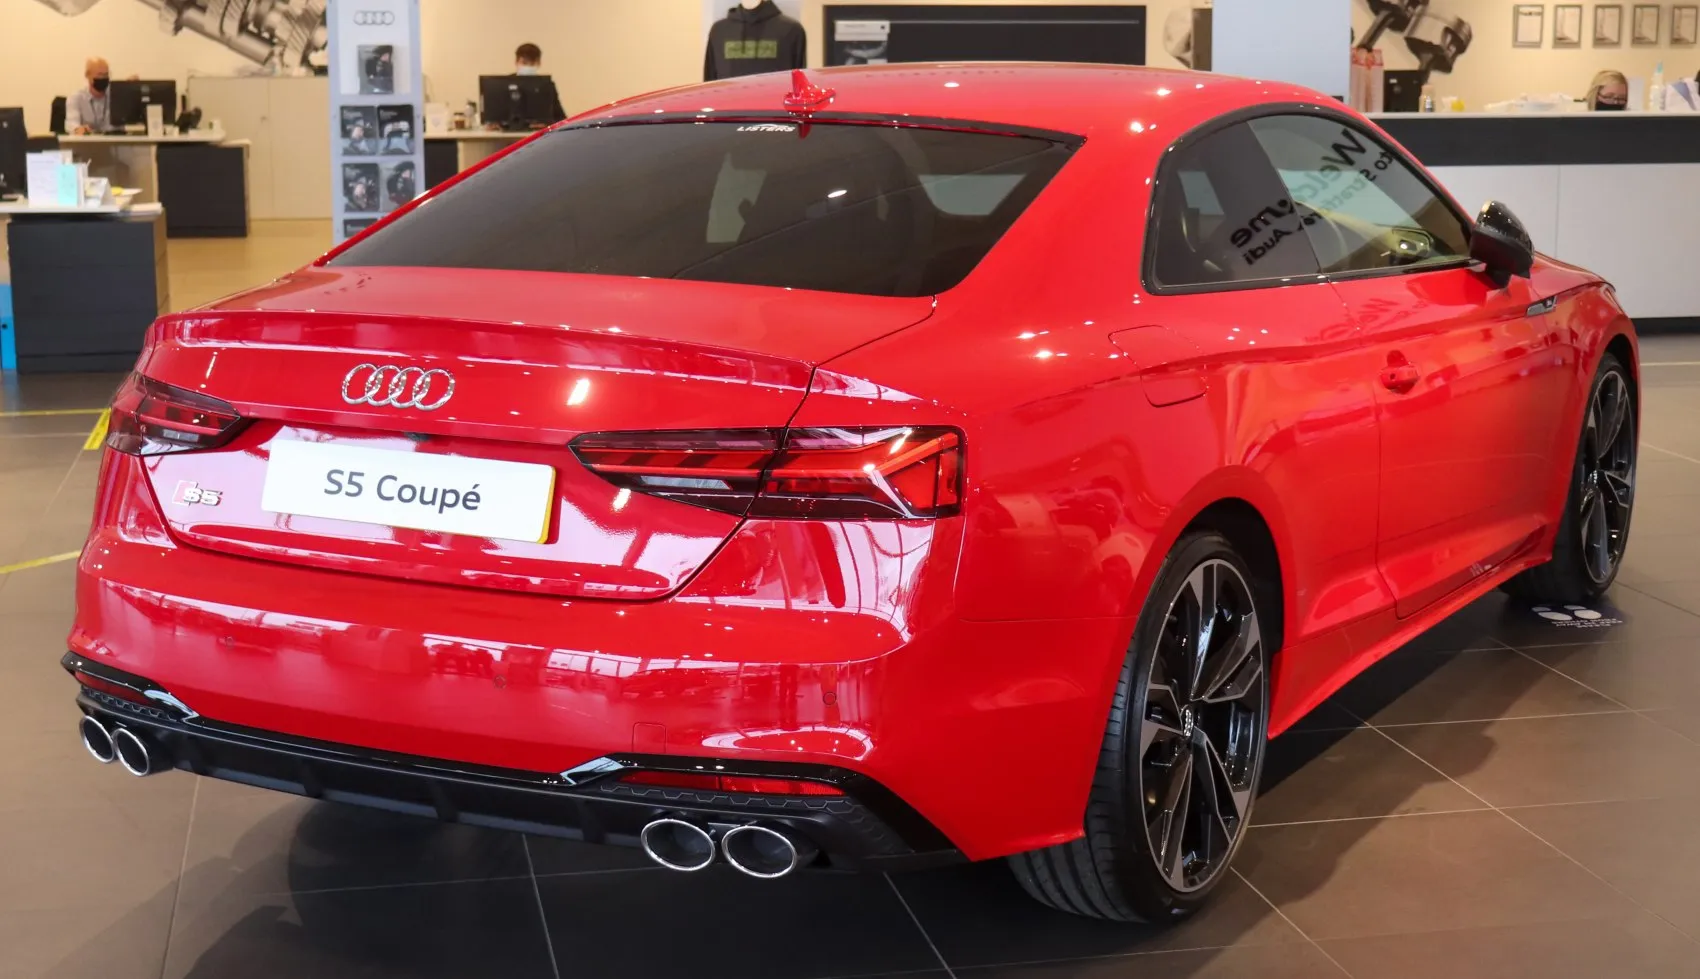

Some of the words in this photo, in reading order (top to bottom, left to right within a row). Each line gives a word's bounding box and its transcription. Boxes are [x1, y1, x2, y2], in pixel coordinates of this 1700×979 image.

[737, 124, 796, 132] LISTERS
[181, 486, 222, 506] S5
[325, 468, 366, 498] S5
[375, 474, 482, 514] Coupé
